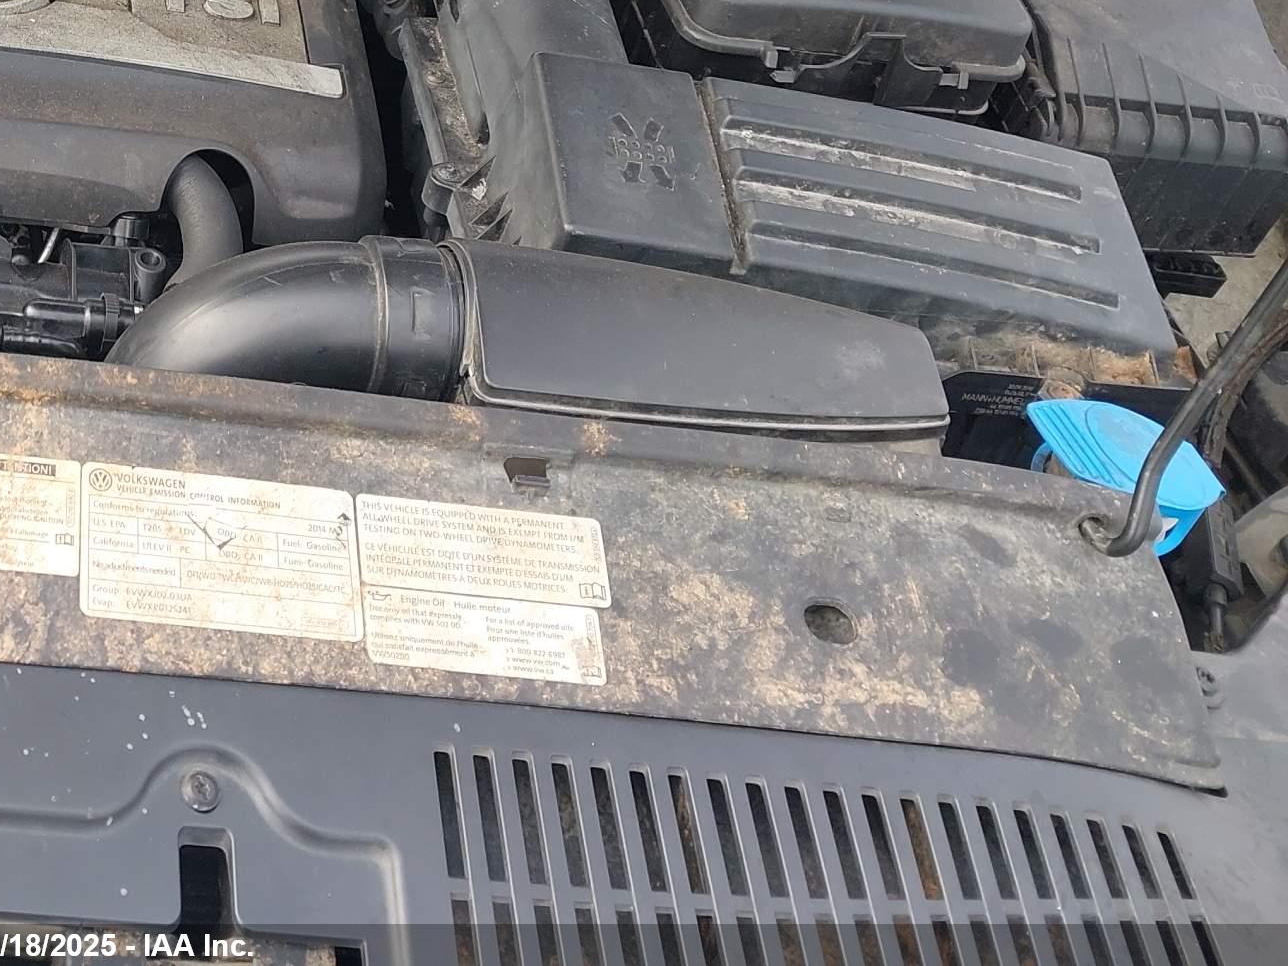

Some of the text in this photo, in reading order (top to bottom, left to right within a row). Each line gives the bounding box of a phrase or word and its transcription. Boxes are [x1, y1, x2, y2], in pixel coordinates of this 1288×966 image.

[117, 473, 185, 488] VOLKSWAGEN
[116, 484, 146, 495] VEHICLE
[149, 488, 185, 498] EMISSION
[227, 496, 281, 509] INFORMATION
[362, 501, 381, 510] THIS
[384, 503, 421, 514] VEHICLE
[431, 508, 475, 521] EQUIPPED
[476, 513, 501, 523] WITH
[511, 517, 564, 530] PERMANENT
[307, 524, 326, 533] 2014
[363, 523, 400, 534] TESTING
[402, 528, 416, 536] ON
[476, 535, 502, 545] DRIVE
[412, 517, 439, 527] DRIVE
[442, 520, 473, 530] SYSTEM
[476, 524, 496, 533] AND
[508, 527, 541, 538] EXEMPT
[543, 531, 568, 541] FROM
[179, 545, 190, 553] PC
[307, 559, 343, 570] Gasoline
[364, 541, 375, 550] CE
[420, 546, 435, 556] EST
[523, 558, 537, 567] DE
[538, 560, 600, 574] TRANSMISSION
[412, 557, 463, 571] PERMANENT
[366, 564, 383, 574] SUR
[467, 574, 492, 586] DEUX
[493, 577, 522, 589] ROUES
[400, 594, 510, 614] Engine Oil Huile moteur
[420, 618, 434, 627] VW
[525, 620, 559, 632] approved
[519, 629, 535, 637] liste
